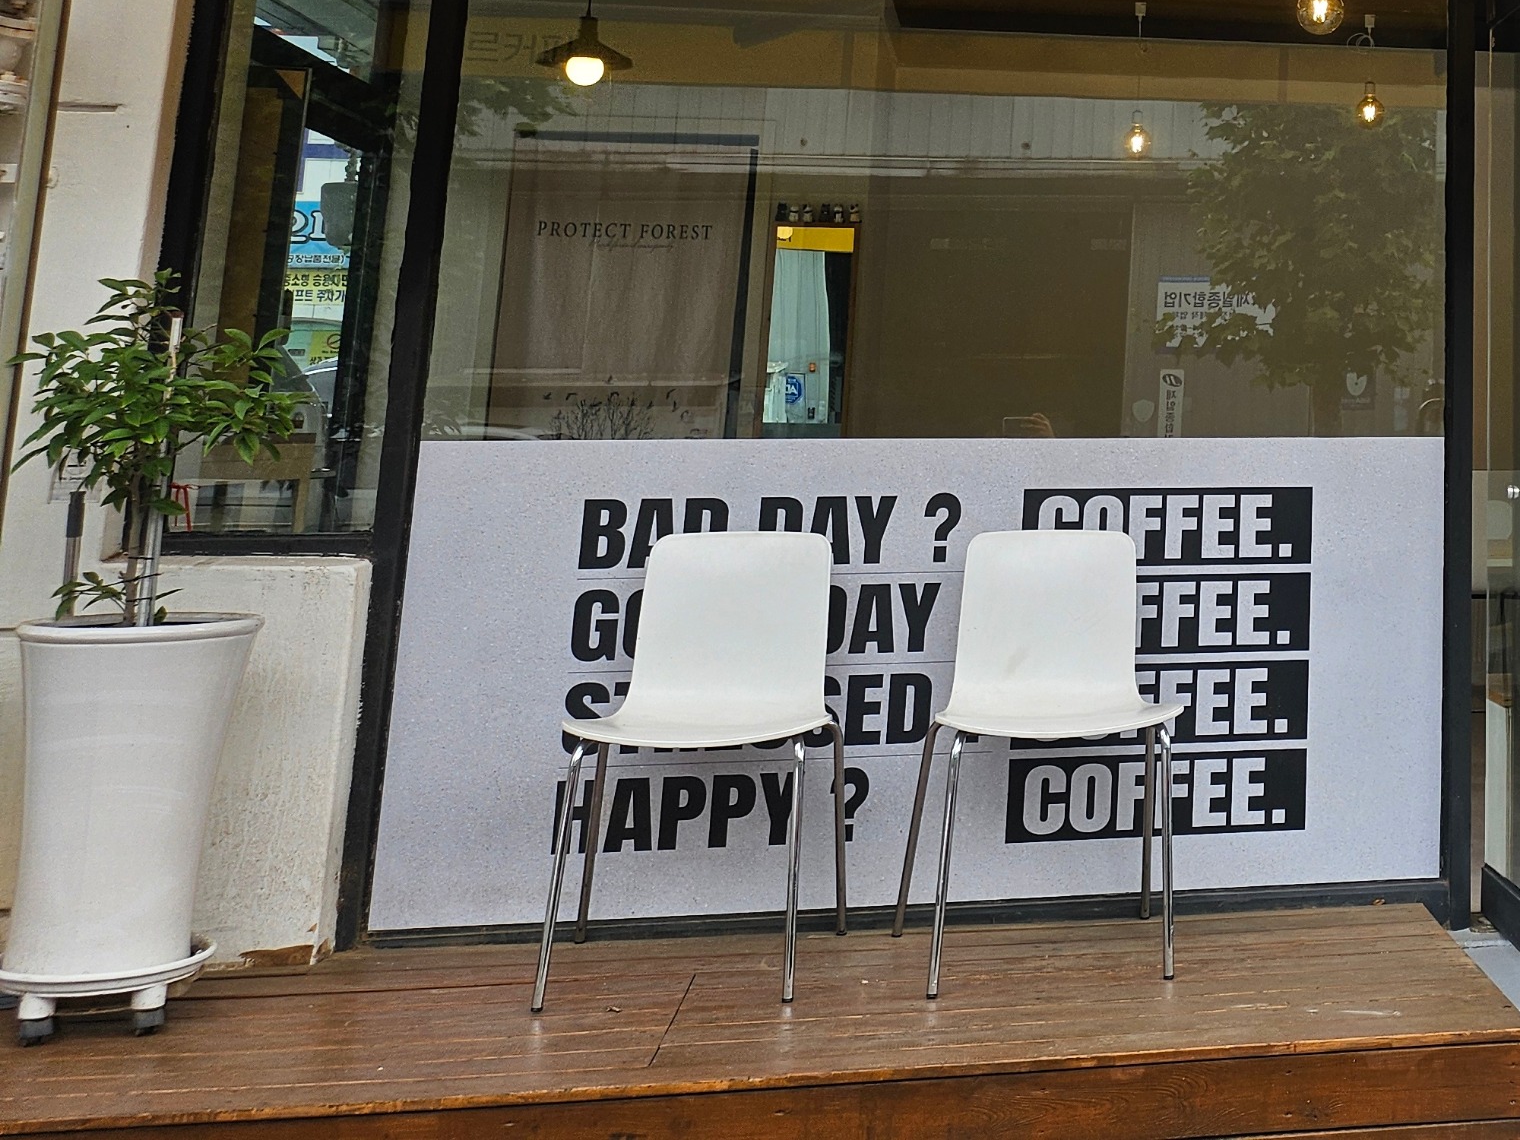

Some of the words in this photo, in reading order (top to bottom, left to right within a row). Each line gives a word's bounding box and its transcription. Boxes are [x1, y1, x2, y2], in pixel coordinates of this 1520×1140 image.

[536, 220, 632, 240] PROTECT
[639, 223, 713, 241] FOREST
[923, 492, 963, 563] ?
[1135, 580, 1291, 648] FFEE.
[550, 771, 796, 855] HAPPY
[1021, 756, 1286, 836] COFFEE.
